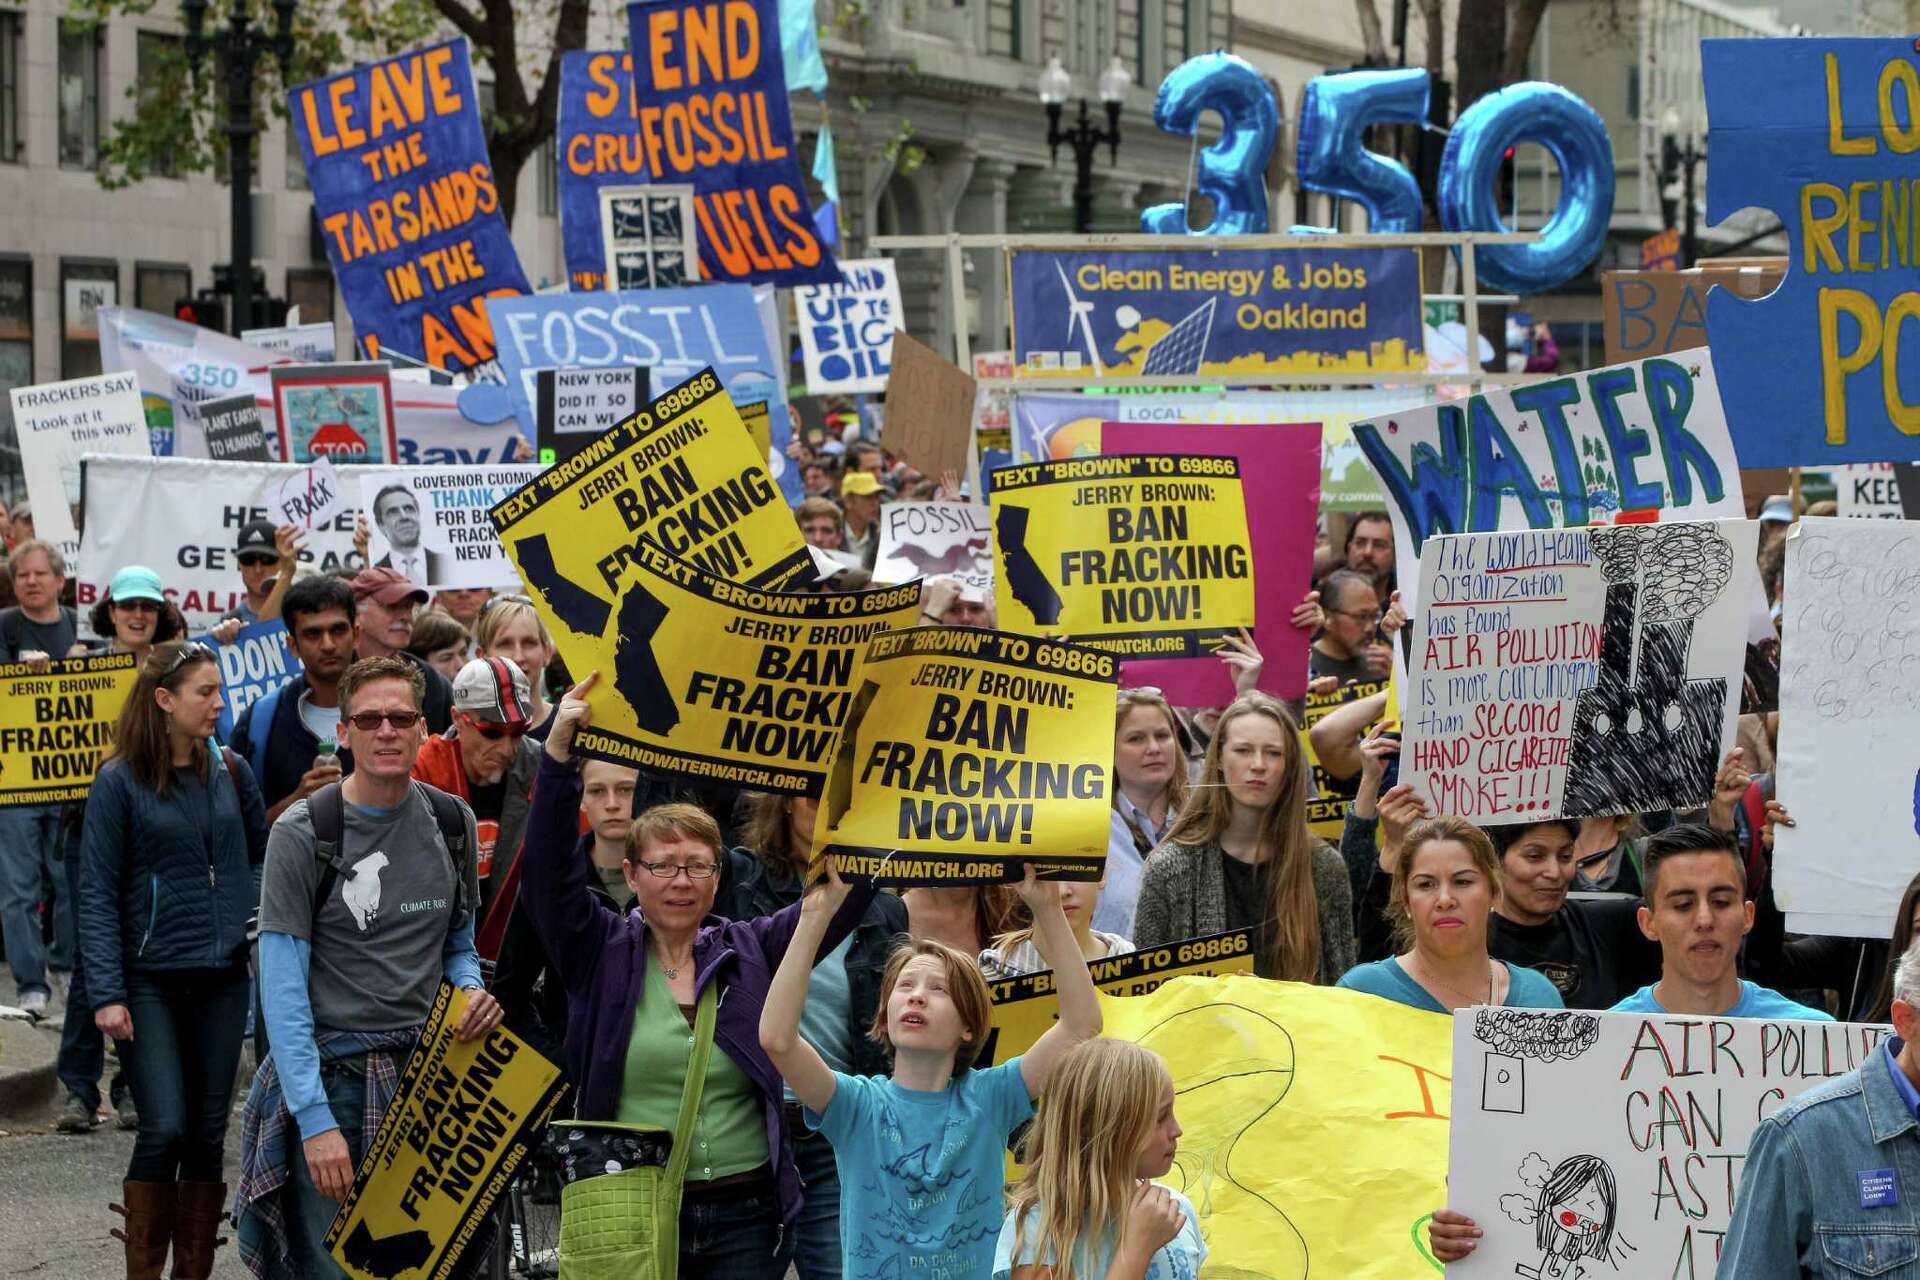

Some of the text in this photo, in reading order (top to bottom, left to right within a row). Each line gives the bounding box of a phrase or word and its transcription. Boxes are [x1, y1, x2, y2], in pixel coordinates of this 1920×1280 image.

[649, 1, 760, 90] END
[301, 47, 463, 157] LEAVE
[640, 91, 788, 178] FOSSIL
[362, 132, 427, 182] THE
[1140, 48, 1617, 293] 350
[324, 163, 498, 264] TARSANDS
[693, 184, 821, 280] UELS
[386, 240, 486, 305] IN THE
[1077, 263, 1368, 295] Clean Energy & Jobs
[808, 297, 859, 323] UP
[1236, 302, 1368, 330] Oakland
[505, 303, 760, 369] FOSSIL
[813, 318, 896, 352] BIG
[184, 363, 238, 388] 350
[558, 371, 632, 387] NEW YORK
[819, 350, 892, 382] OIL
[18, 377, 136, 408] FRACKERS SAY
[559, 394, 626, 408] DID IT SO
[71, 424, 101, 442] this
[74, 413, 89, 427] at
[91, 409, 104, 424] it
[558, 413, 616, 427] CAN WE
[1127, 407, 1185, 421] LOCAL
[210, 440, 226, 457] TO
[493, 485, 539, 527] TEXT
[538, 429, 621, 490] "BROWN"
[621, 412, 654, 440] TO
[655, 373, 717, 418] 69866
[577, 416, 709, 512] JERRY BROWN:
[1351, 358, 1726, 559] WATER
[413, 474, 484, 490] GOVERNOR
[992, 456, 1236, 488] TEXT "BROWN" TO 69866
[281, 477, 335, 525] FRACK
[430, 488, 497, 509] THANK
[612, 455, 699, 533] BAN
[1072, 483, 1216, 507] JERRY BROWN:
[435, 510, 466, 526] FOR
[595, 465, 777, 597] FRCKING
[890, 505, 992, 542] FOSSIL
[1107, 505, 1189, 544] BAN
[455, 545, 492, 561] NEW
[1060, 544, 1249, 587] FRACKING
[1434, 537, 1477, 572] The
[1486, 531, 1538, 571] World
[637, 541, 919, 615] TEXT "BROWN" TO 69866
[1432, 572, 1564, 602] Organization
[1101, 584, 1203, 625] NOW!
[1428, 605, 1511, 637] has found
[724, 616, 801, 644] JERRY
[1424, 621, 1606, 671] AIR POLLUTION
[64, 659, 85, 673] TO
[88, 654, 134, 671] 69866
[219, 629, 305, 687] DON'
[755, 644, 855, 687] BAN
[872, 631, 1113, 677] TEXT "BROWN" TO 69866
[9, 676, 116, 697] JERRY BROWN:
[911, 663, 1074, 710] JERRY BROWN:
[1353, 683, 1378, 698] TO
[1421, 679, 1437, 706] is
[1449, 671, 1490, 706] more
[35, 694, 94, 723] BAN
[925, 693, 1030, 755] BAN
[1417, 710, 1465, 735] than
[573, 731, 808, 791] FOODANDWATERWATCH.ORG
[716, 717, 840, 765] NOW!
[1413, 736, 1570, 774] HAND CIGARETTE
[860, 740, 1105, 801] FRACKING
[1422, 769, 1552, 821] SMOKE!!!
[897, 796, 1034, 845] NOW!
[400, 900, 431, 914] CLIMATE
[1138, 949, 1171, 971] TO
[1177, 933, 1249, 964] 69866
[1621, 1018, 1897, 1082] AIR POLLUT
[326, 981, 452, 1244] TEXT "BROWN" TO 69866
[383, 1022, 460, 1173] JERRY BROWN:
[406, 1065, 458, 1155] BAN
[399, 1031, 520, 1222] FRACKING
[1626, 1086, 1722, 1152] CAN
[438, 1097, 517, 1205] NOW!
[510, 1223, 526, 1261] JUDY
